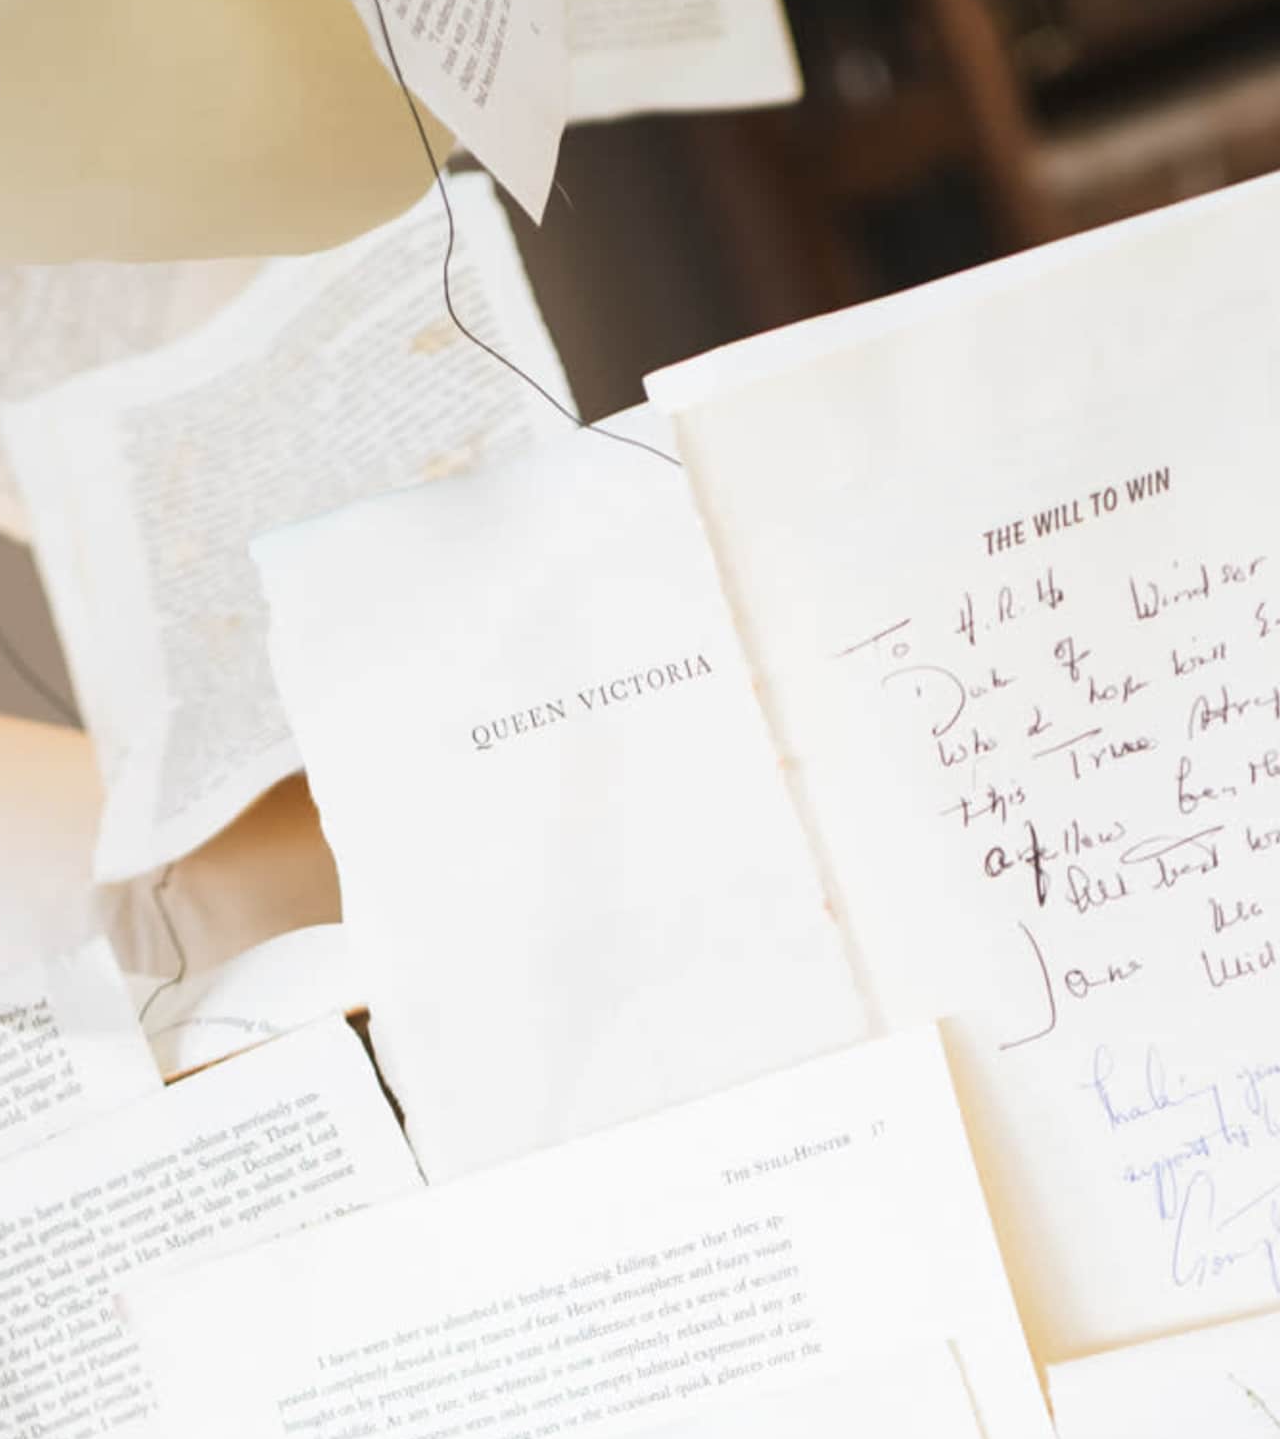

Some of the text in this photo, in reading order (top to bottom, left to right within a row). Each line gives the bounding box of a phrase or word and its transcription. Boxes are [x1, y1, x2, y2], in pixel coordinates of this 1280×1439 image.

[983, 466, 1171, 555] THE WILL TO WIN
[1129, 557, 1268, 621] Windsor
[471, 654, 713, 751] QUEEN VICTORIA
